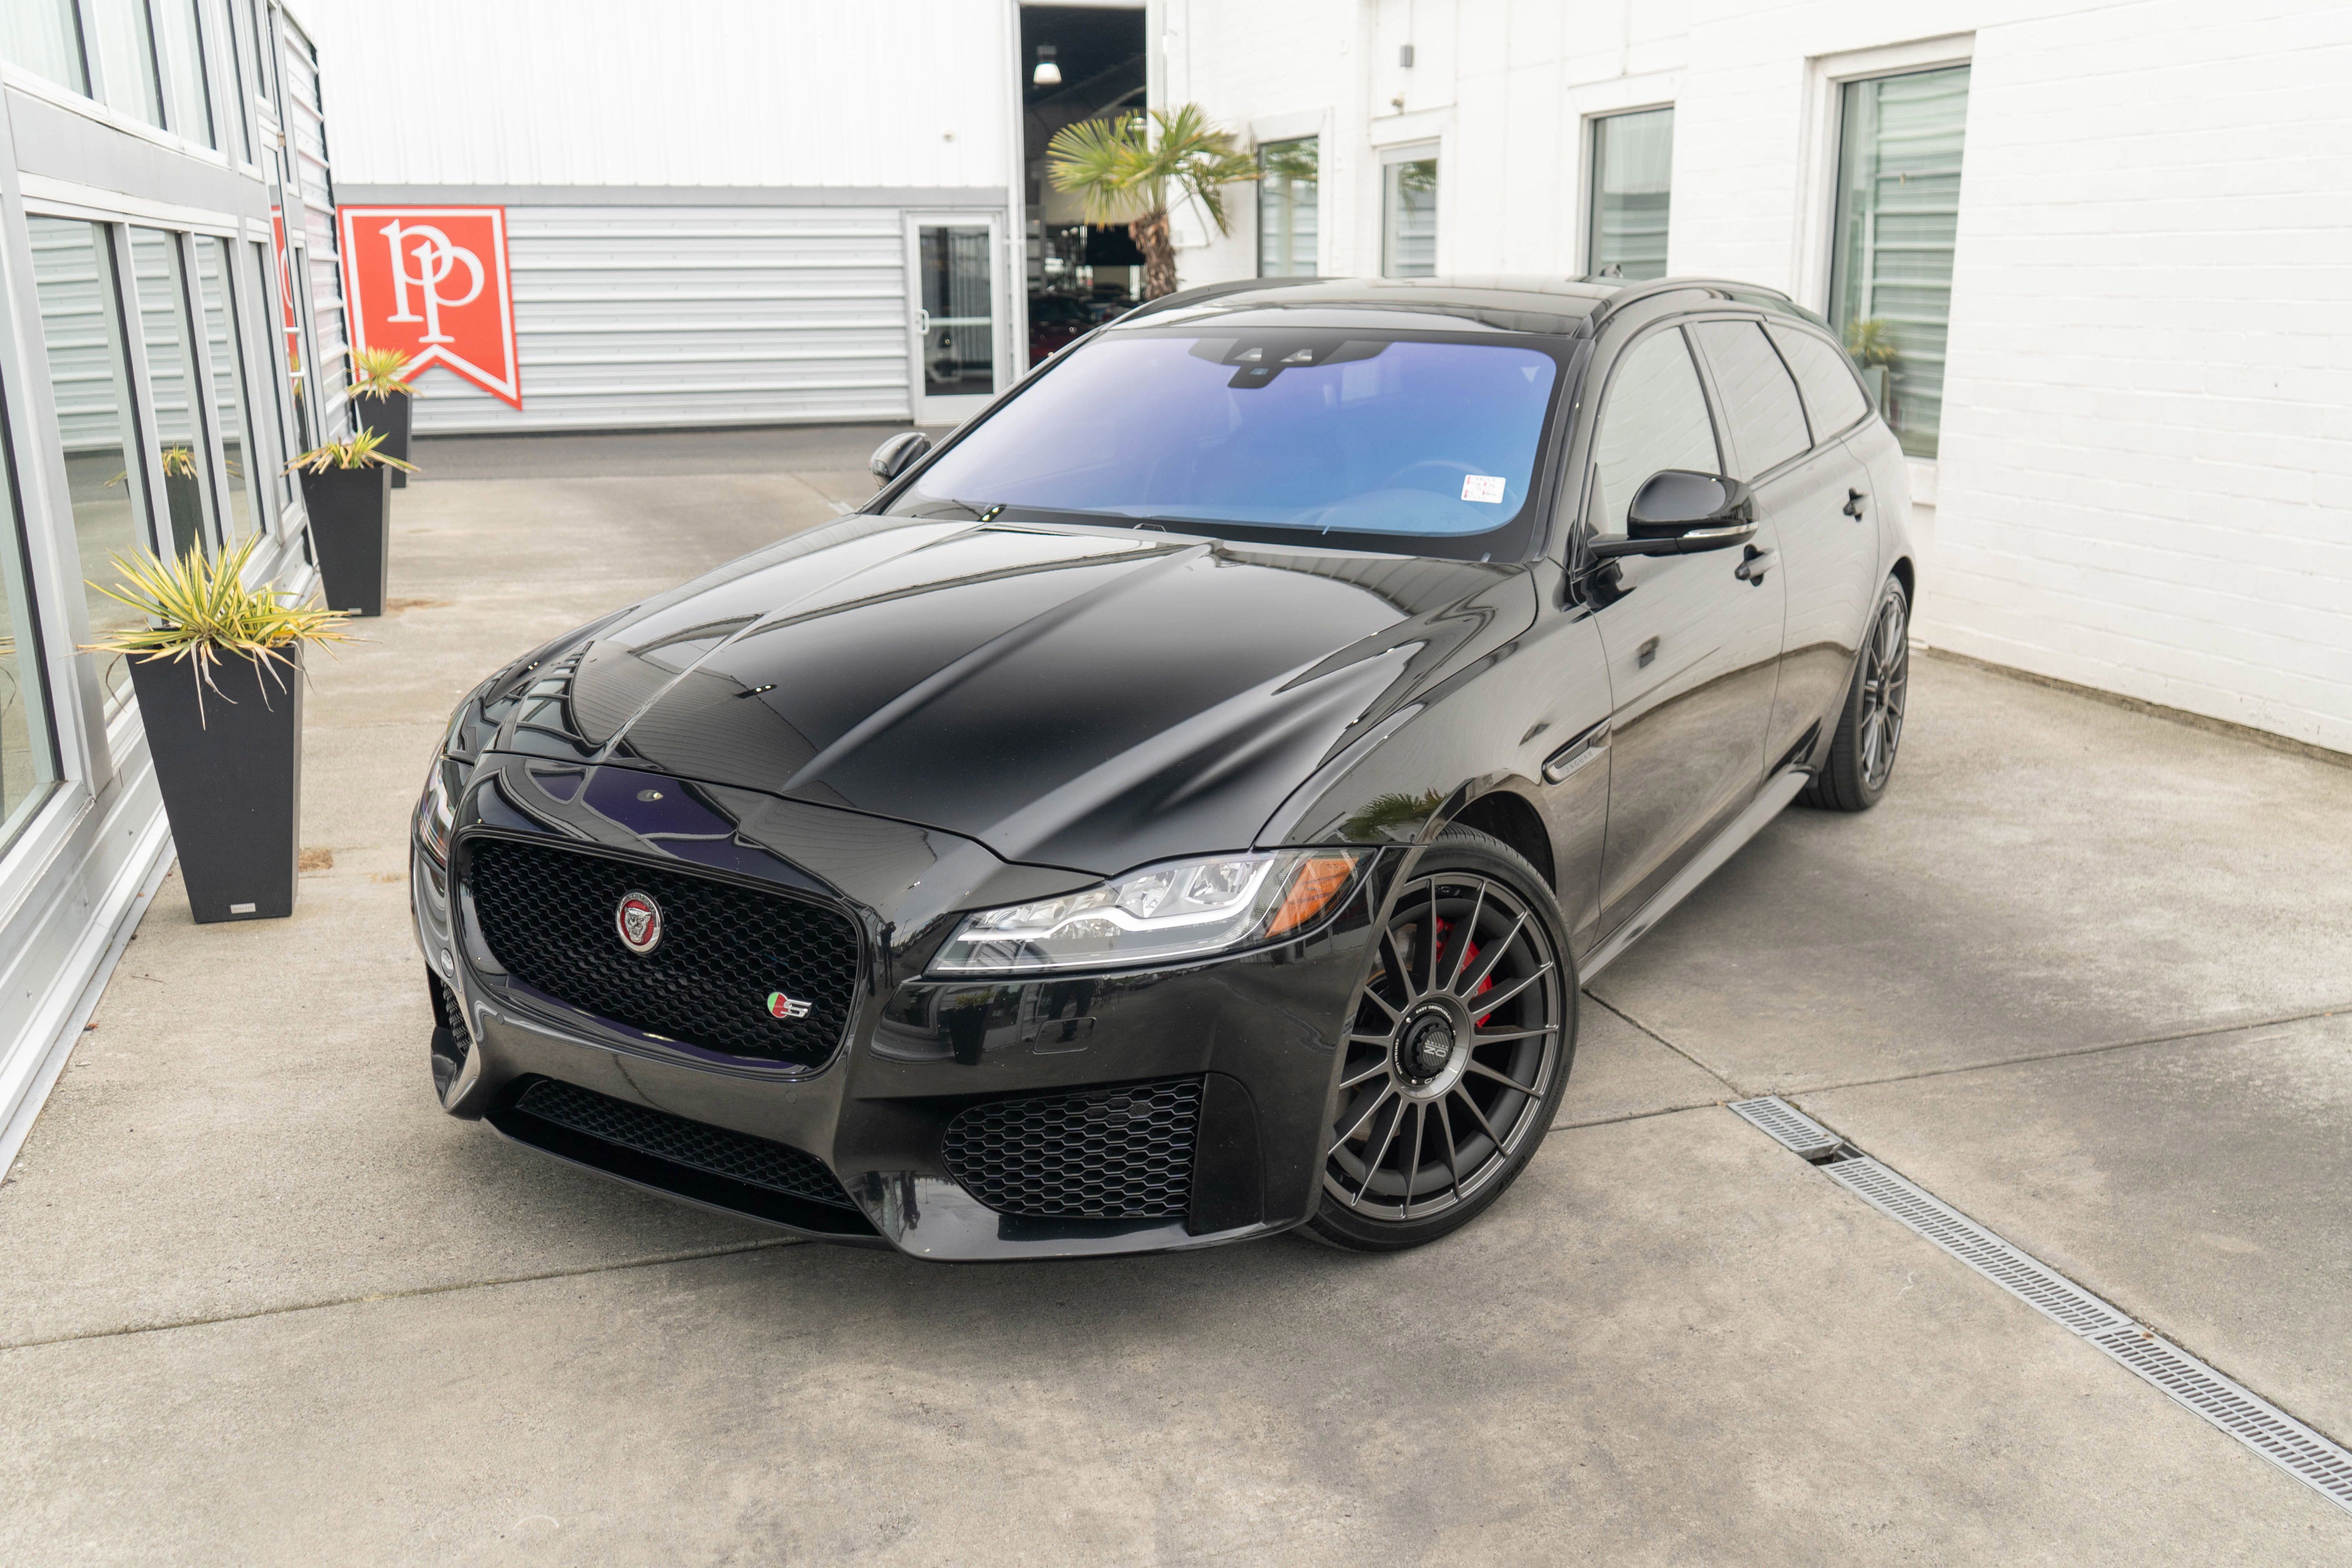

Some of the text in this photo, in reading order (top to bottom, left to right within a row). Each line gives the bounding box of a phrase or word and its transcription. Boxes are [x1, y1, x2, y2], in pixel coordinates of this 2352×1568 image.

[1565, 752, 1592, 772] JAGUAR
[621, 894, 655, 913] JAGUAR
[1428, 1005, 1452, 1022] SUPERTURISMO
